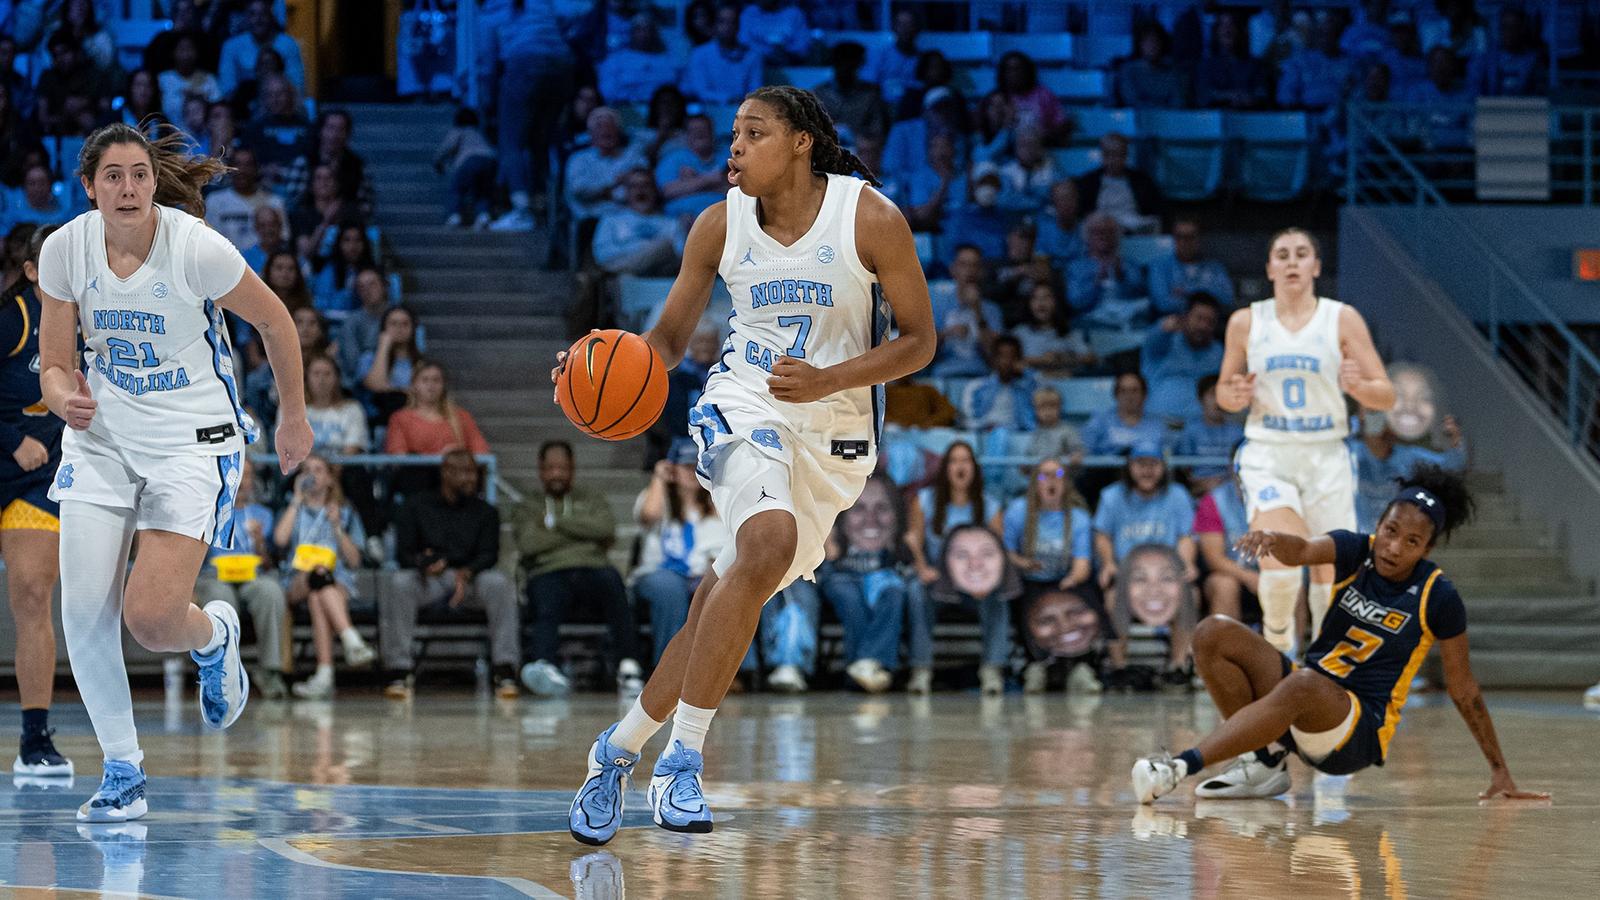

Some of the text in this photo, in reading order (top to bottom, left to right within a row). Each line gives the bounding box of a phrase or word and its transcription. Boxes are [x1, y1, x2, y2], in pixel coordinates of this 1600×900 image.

[750, 280, 834, 309] NORTH
[93, 309, 166, 335] NORTH
[778, 315, 812, 359] 7
[106, 337, 160, 369] 21
[1282, 377, 1306, 410] 0
[1339, 586, 1411, 635] UNCG
[1317, 626, 1384, 678] 2
